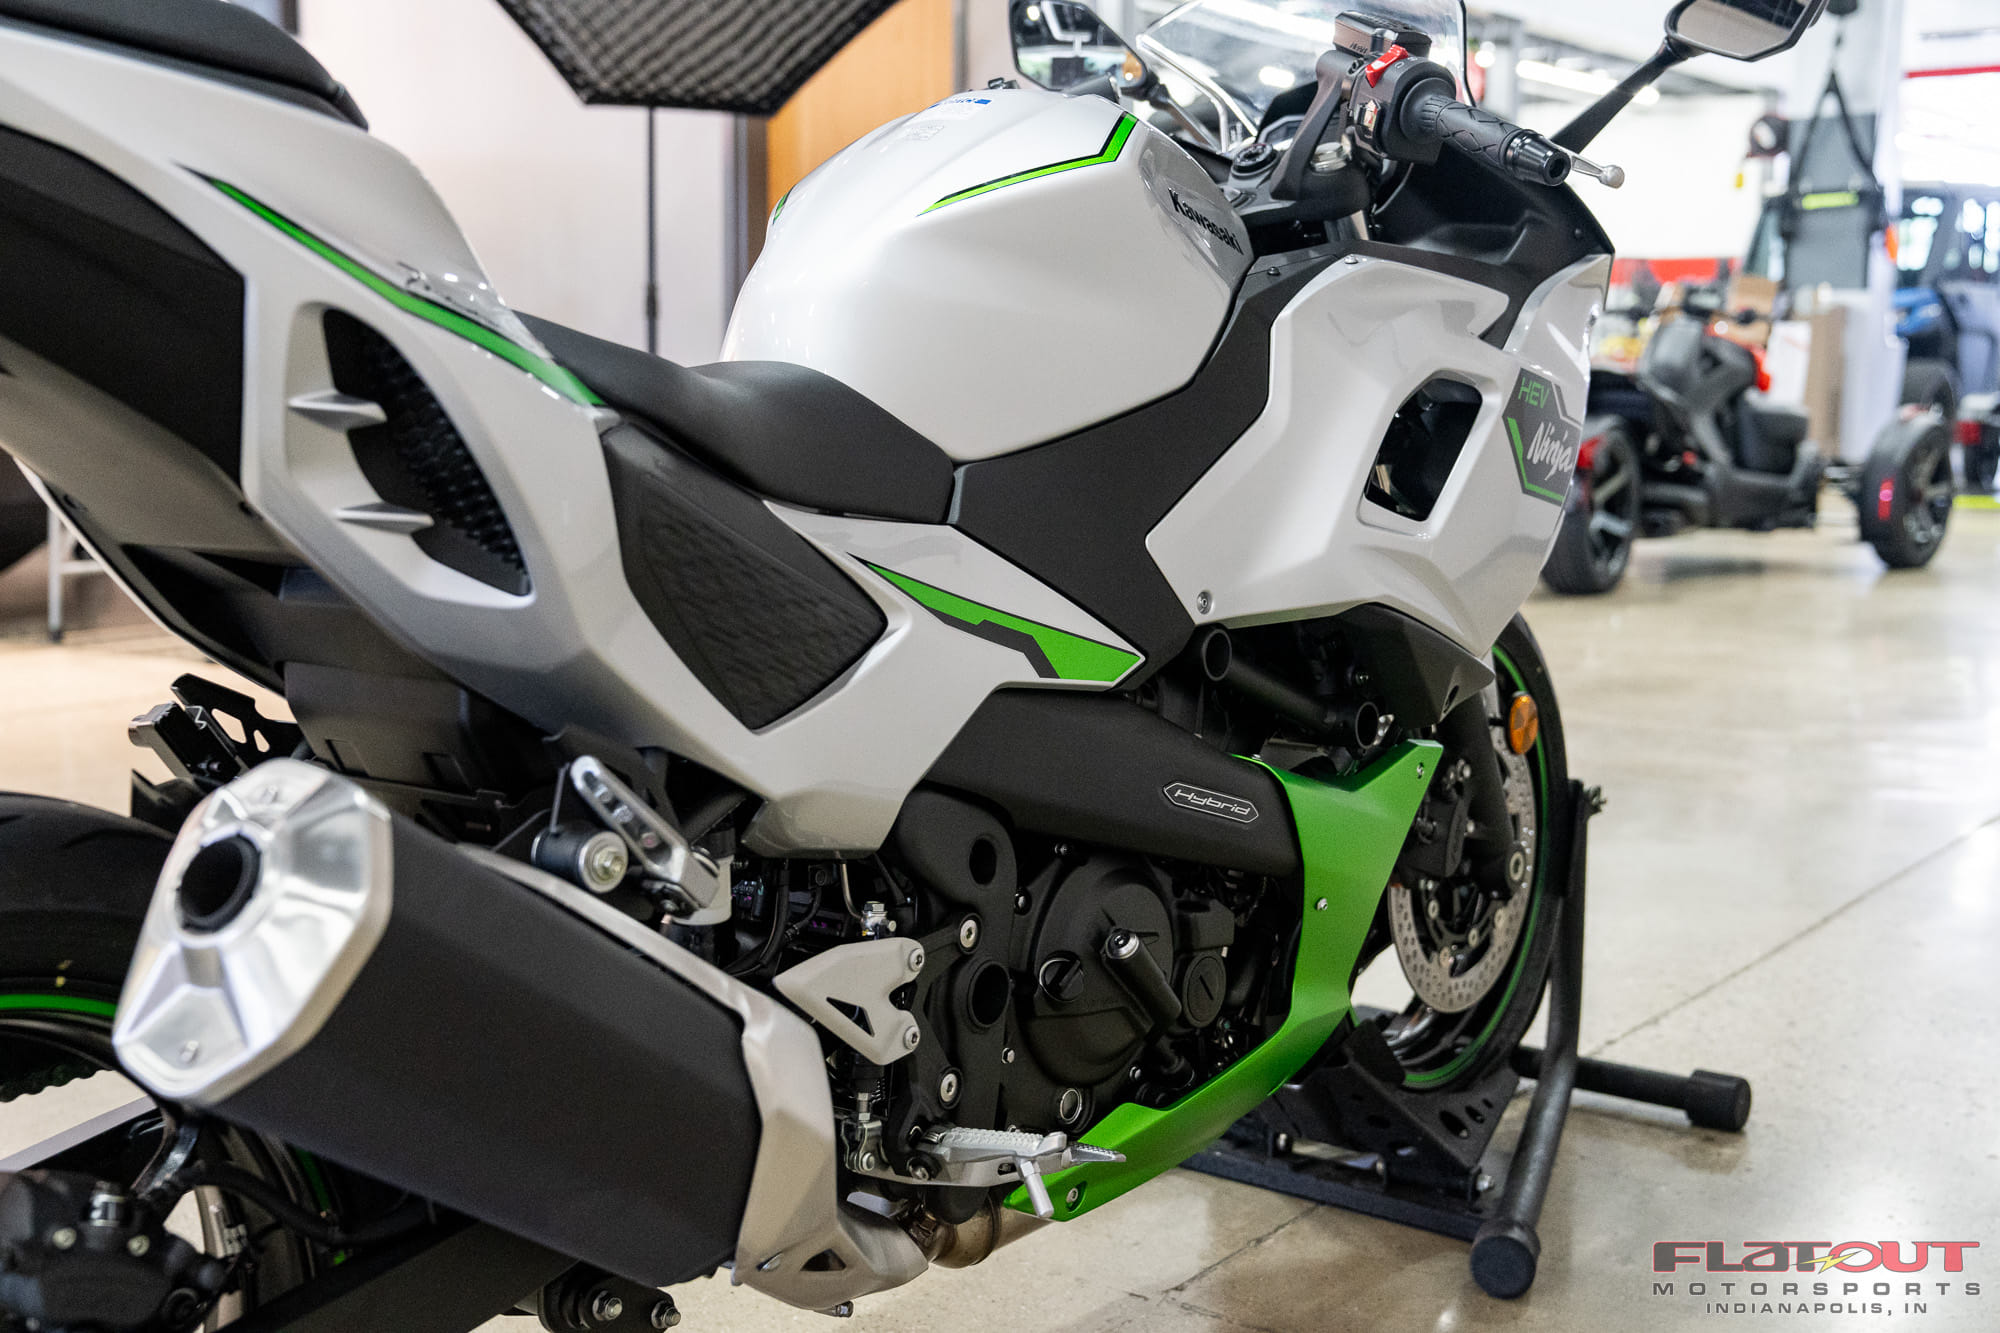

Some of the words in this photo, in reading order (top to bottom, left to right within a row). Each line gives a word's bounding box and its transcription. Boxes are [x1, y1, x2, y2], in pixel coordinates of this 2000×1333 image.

[1168, 188, 1244, 256] Kawasaki
[1518, 377, 1550, 408] HEV
[1527, 421, 1574, 481] Ninja
[1174, 789, 1251, 816] Hybrid
